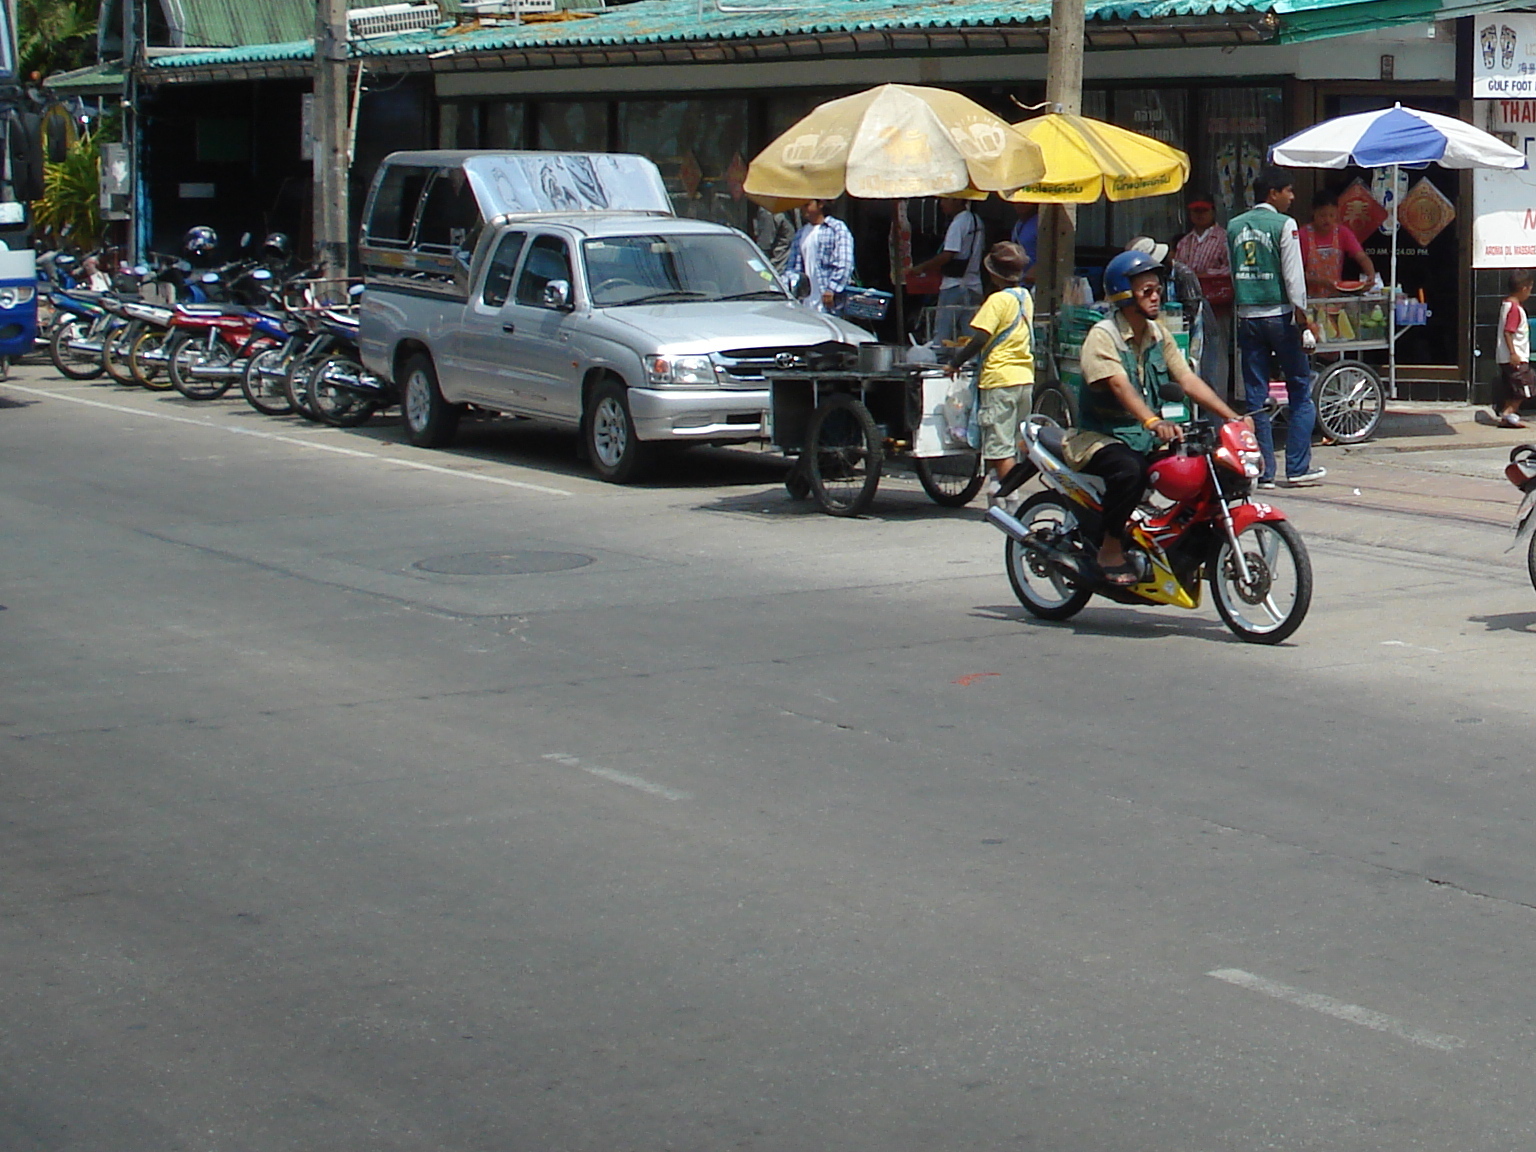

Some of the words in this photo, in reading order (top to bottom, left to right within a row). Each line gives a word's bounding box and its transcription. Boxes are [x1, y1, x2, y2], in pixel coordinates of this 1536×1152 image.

[1488, 80, 1509, 91] GULF
[1512, 80, 1532, 91] FOOT
[1500, 101, 1536, 124] THAI
[1244, 241, 1257, 266] 2
